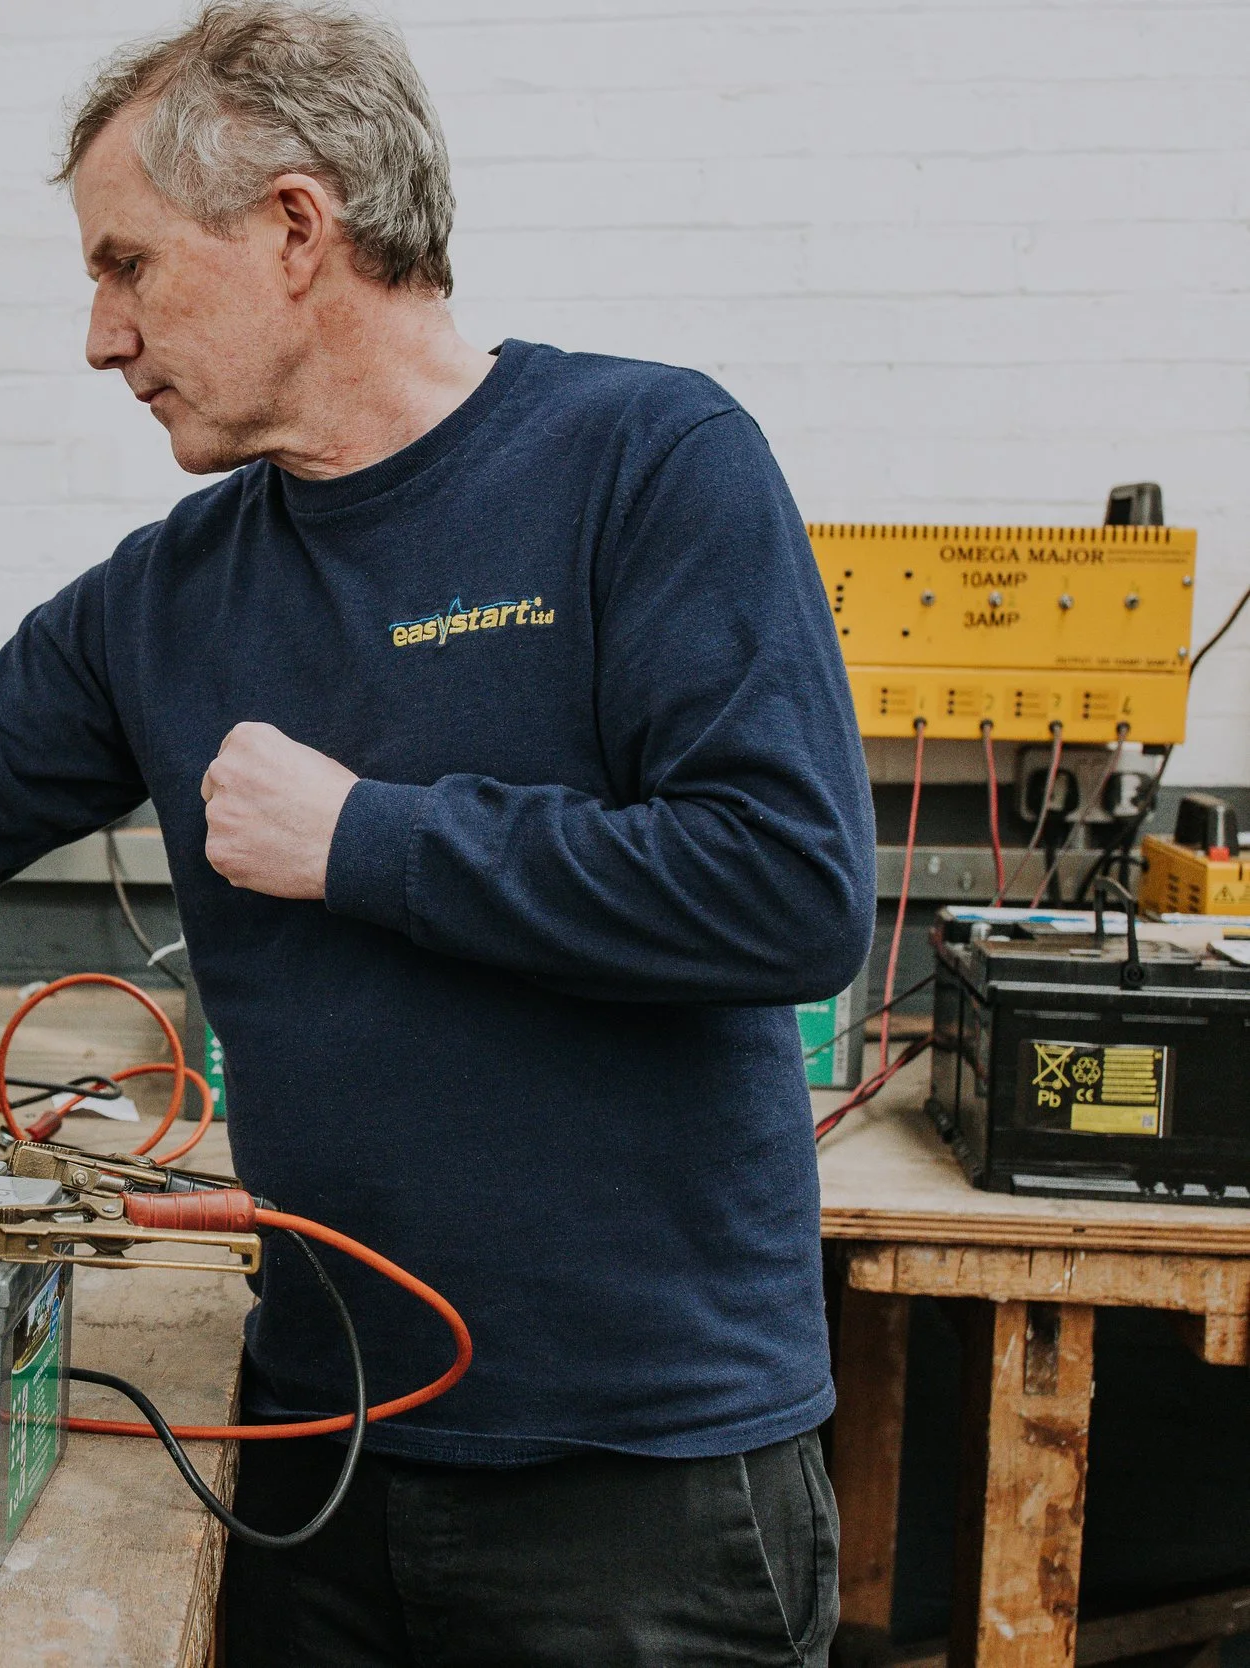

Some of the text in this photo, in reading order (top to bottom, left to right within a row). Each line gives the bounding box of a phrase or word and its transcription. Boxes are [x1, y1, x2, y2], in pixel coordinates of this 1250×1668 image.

[939, 546, 1020, 564] OMEGA
[1027, 548, 1105, 566] MAJOR
[961, 570, 1028, 588] 10AMP
[392, 600, 555, 647] easystart Ltd
[963, 610, 1020, 628] 3AMP
[1037, 1089, 1062, 1108] Pb
